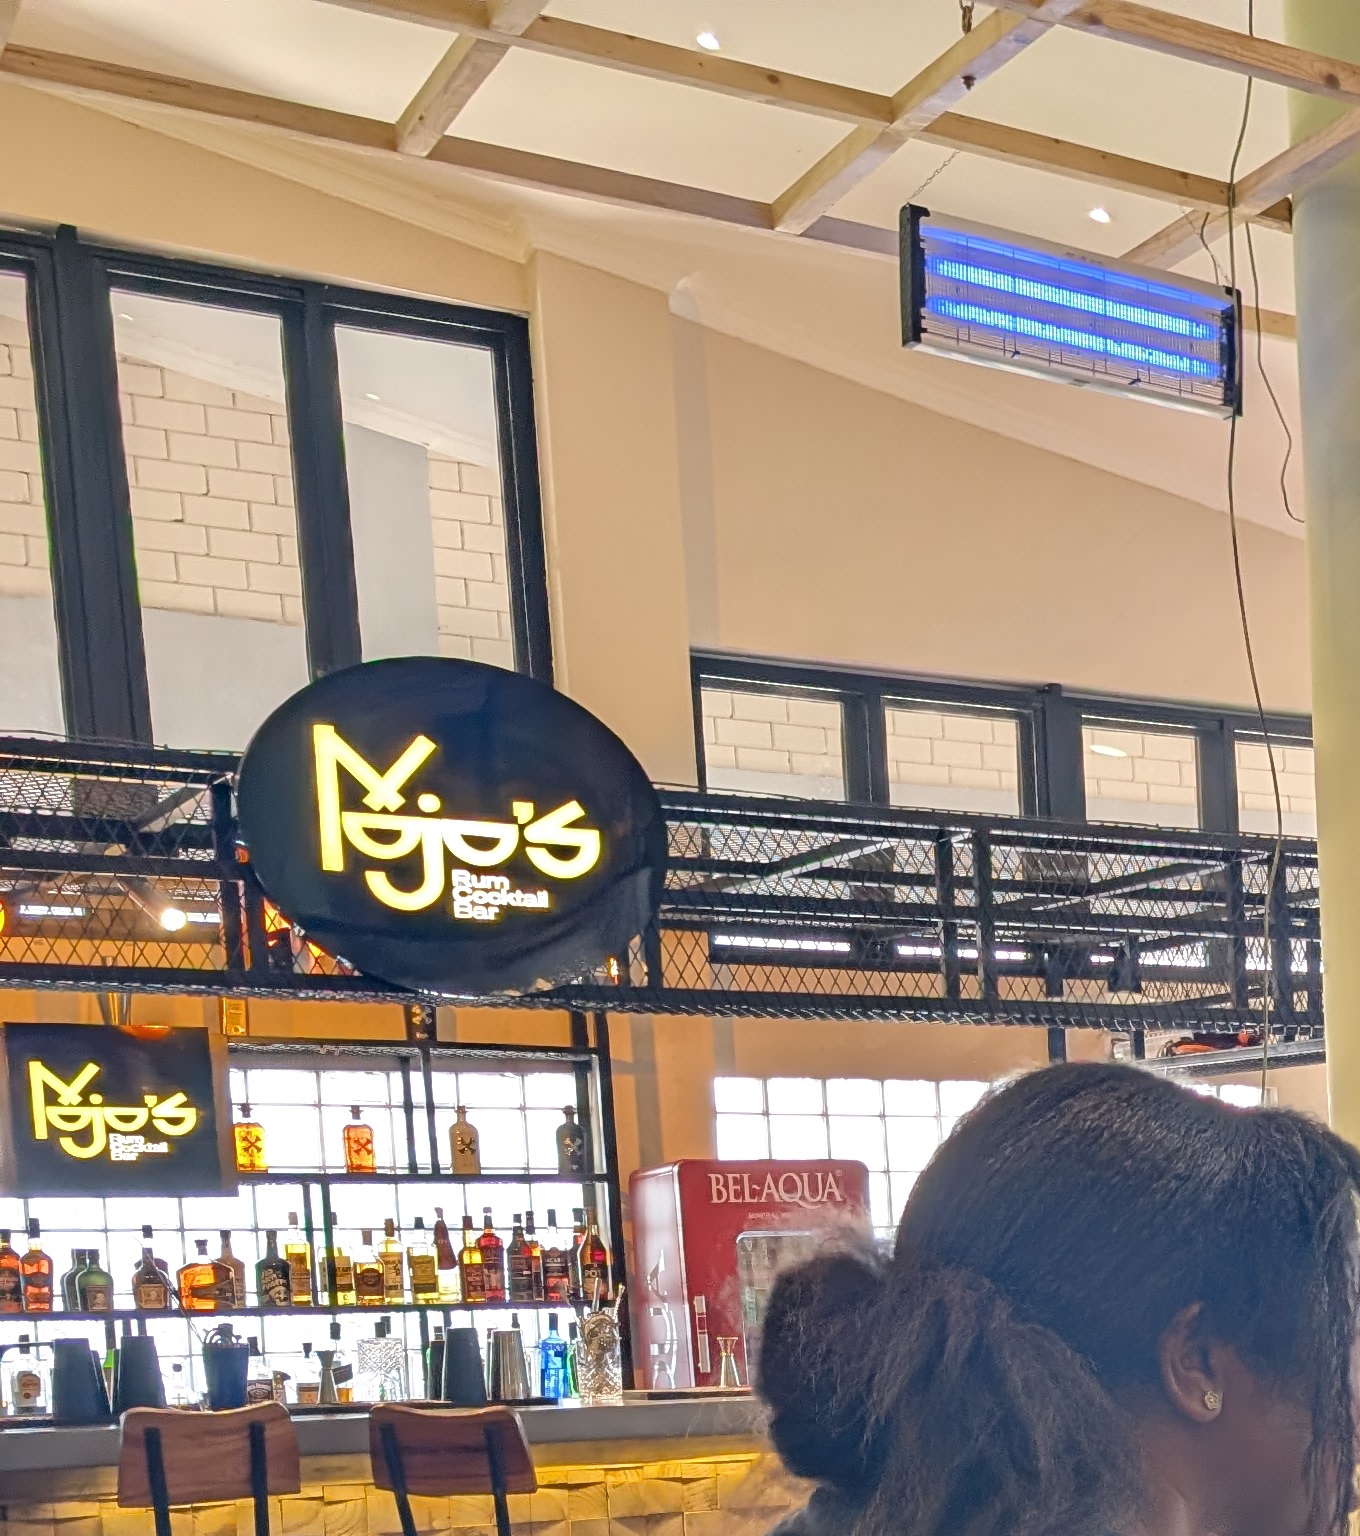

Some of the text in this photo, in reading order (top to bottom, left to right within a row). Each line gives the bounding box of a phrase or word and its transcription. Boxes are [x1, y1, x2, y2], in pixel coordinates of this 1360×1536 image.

[451, 869, 510, 892] Rum
[452, 886, 549, 909] Cocktail
[453, 902, 501, 921] Bar
